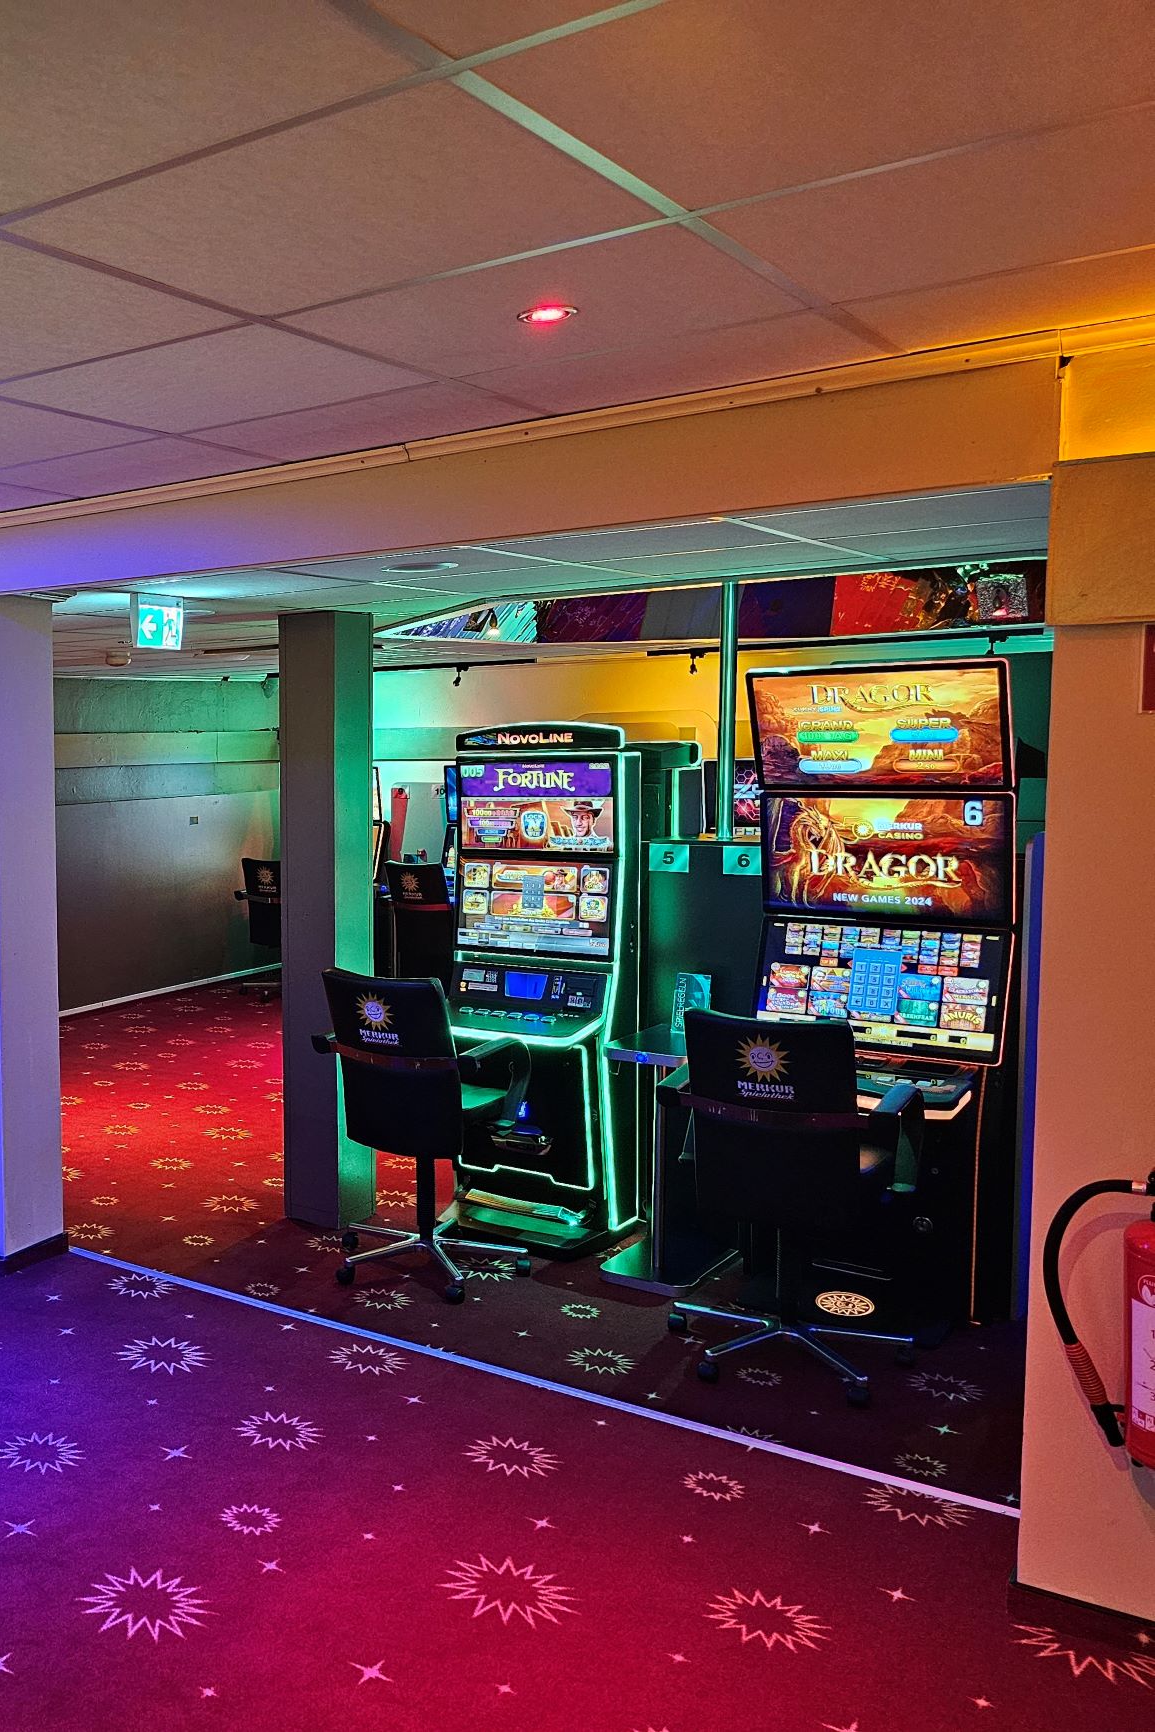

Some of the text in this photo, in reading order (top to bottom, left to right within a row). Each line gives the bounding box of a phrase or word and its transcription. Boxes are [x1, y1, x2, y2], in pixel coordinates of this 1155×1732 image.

[807, 683, 940, 709] DRAGOR
[799, 720, 853, 731] GRAND
[896, 717, 951, 729] SUPER
[811, 750, 848, 760] MAXI
[909, 749, 944, 761] MINI
[462, 767, 484, 778] 005
[493, 769, 576, 792] FORTUNE
[963, 800, 984, 827] 6
[878, 822, 923, 831] MERKUR
[877, 832, 924, 840] CASINO
[662, 851, 675, 864] 5
[737, 853, 751, 867] 6
[807, 850, 962, 889] DRAGOR
[833, 892, 932, 906] NEW GAMES 2024
[359, 1028, 399, 1041] MERKUR
[737, 1080, 795, 1094] MERKUR
